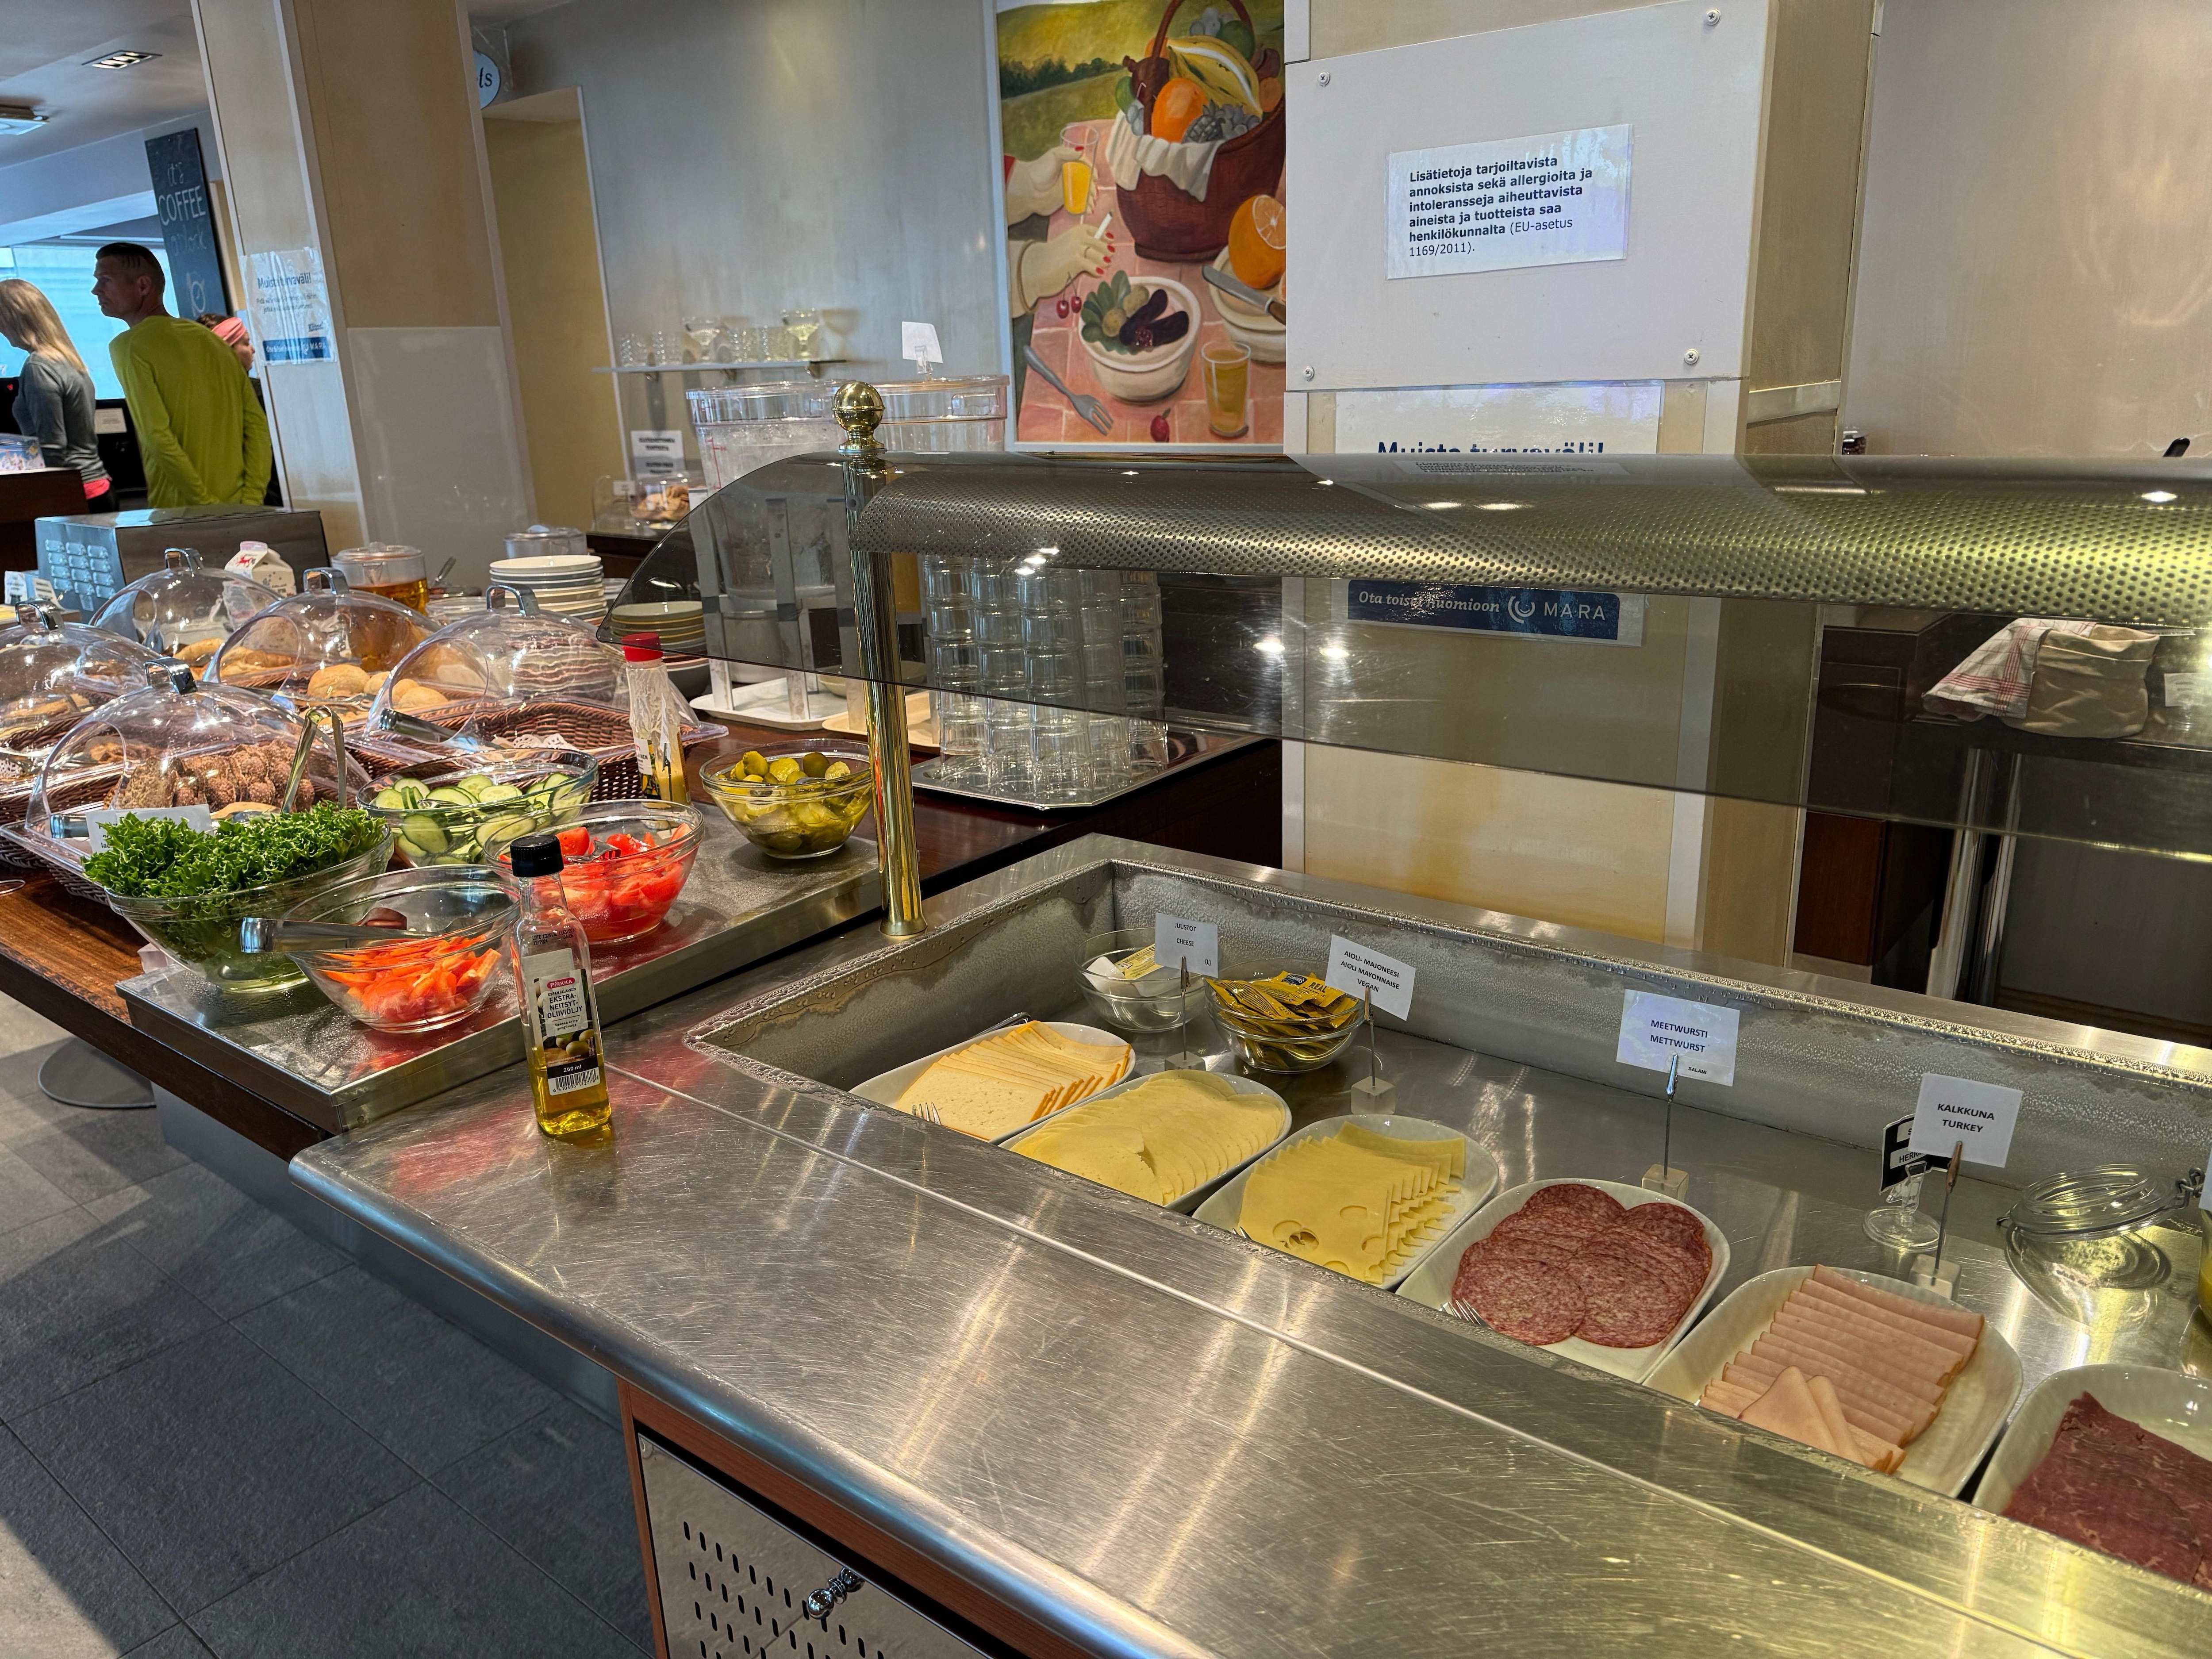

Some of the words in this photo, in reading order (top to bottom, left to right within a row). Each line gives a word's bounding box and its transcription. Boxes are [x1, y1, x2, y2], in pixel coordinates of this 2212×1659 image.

[1410, 166, 1472, 182] Lisätietoja
[1476, 157, 1557, 175] tarjoiltavista
[1409, 182, 1473, 197] annoksista
[1478, 177, 1505, 190] sekä
[1510, 170, 1575, 186] allergioita
[1579, 168, 1592, 181] ja
[158, 185, 206, 226] COFFEE
[1409, 194, 1494, 212] intoleransseja
[1498, 186, 1582, 203] aiheuttavista
[1409, 214, 1455, 227] aineista
[1459, 212, 1470, 225] ja
[1475, 207, 1535, 221] tuotteista
[1540, 205, 1561, 215] saa
[1409, 224, 1505, 242] henkilökunnalta
[1510, 219, 1573, 235] (EU-asetus
[1409, 242, 1475, 257] 1169/2011).
[1359, 591, 1382, 603] Ota
[1427, 596, 1499, 613] huomioon
[1544, 602, 1606, 620] MARA
[1175, 923, 1196, 932] JUUSTOT
[1176, 938, 1194, 947] CHEESE
[1344, 951, 1362, 961] AIOLI-
[1364, 959, 1399, 978] MAJONEESI
[1340, 961, 1356, 971] AIOLI
[1358, 968, 1400, 990] MAYONNAISE
[1309, 982, 1328, 993] REAL
[1358, 979, 1379, 992] VEGAN
[549, 993, 576, 1003] EKSTRA-
[549, 1000, 579, 1011] NEITSYT-
[547, 1006, 583, 1018] OLIIVIÖLJY
[1651, 1020, 1708, 1038] MEETWURSTI
[1650, 1035, 1705, 1052] METTWURST
[1937, 1104, 1994, 1120] KALKKUNA
[1942, 1119, 1984, 1133] TURKEY
